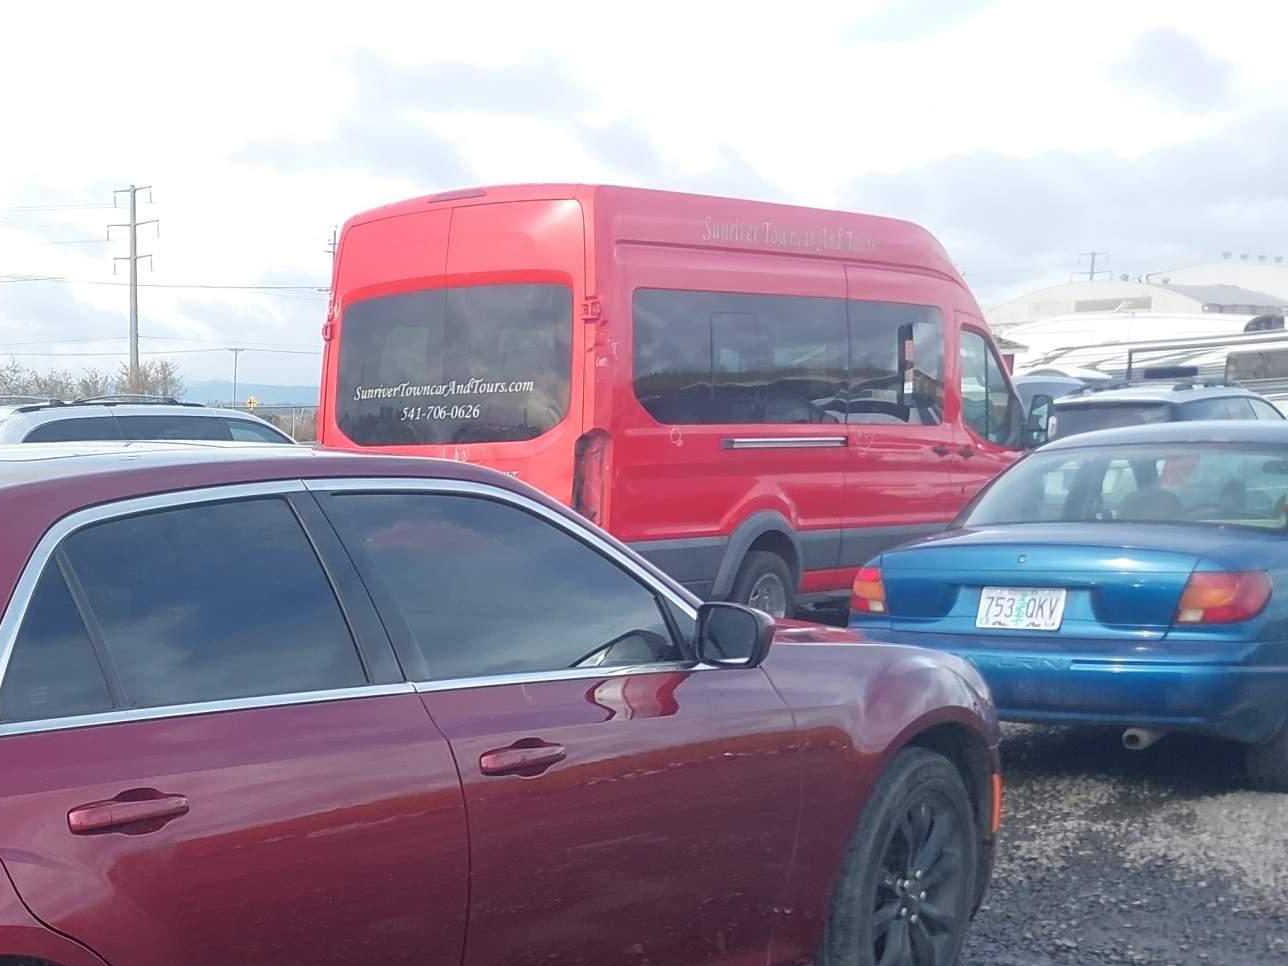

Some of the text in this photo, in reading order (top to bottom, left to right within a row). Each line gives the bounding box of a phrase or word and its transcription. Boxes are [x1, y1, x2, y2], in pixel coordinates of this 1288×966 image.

[353, 377, 534, 400] SunriverTowncarAndTours.com
[400, 404, 480, 421] 541-706-0626
[984, 597, 1015, 618] 753
